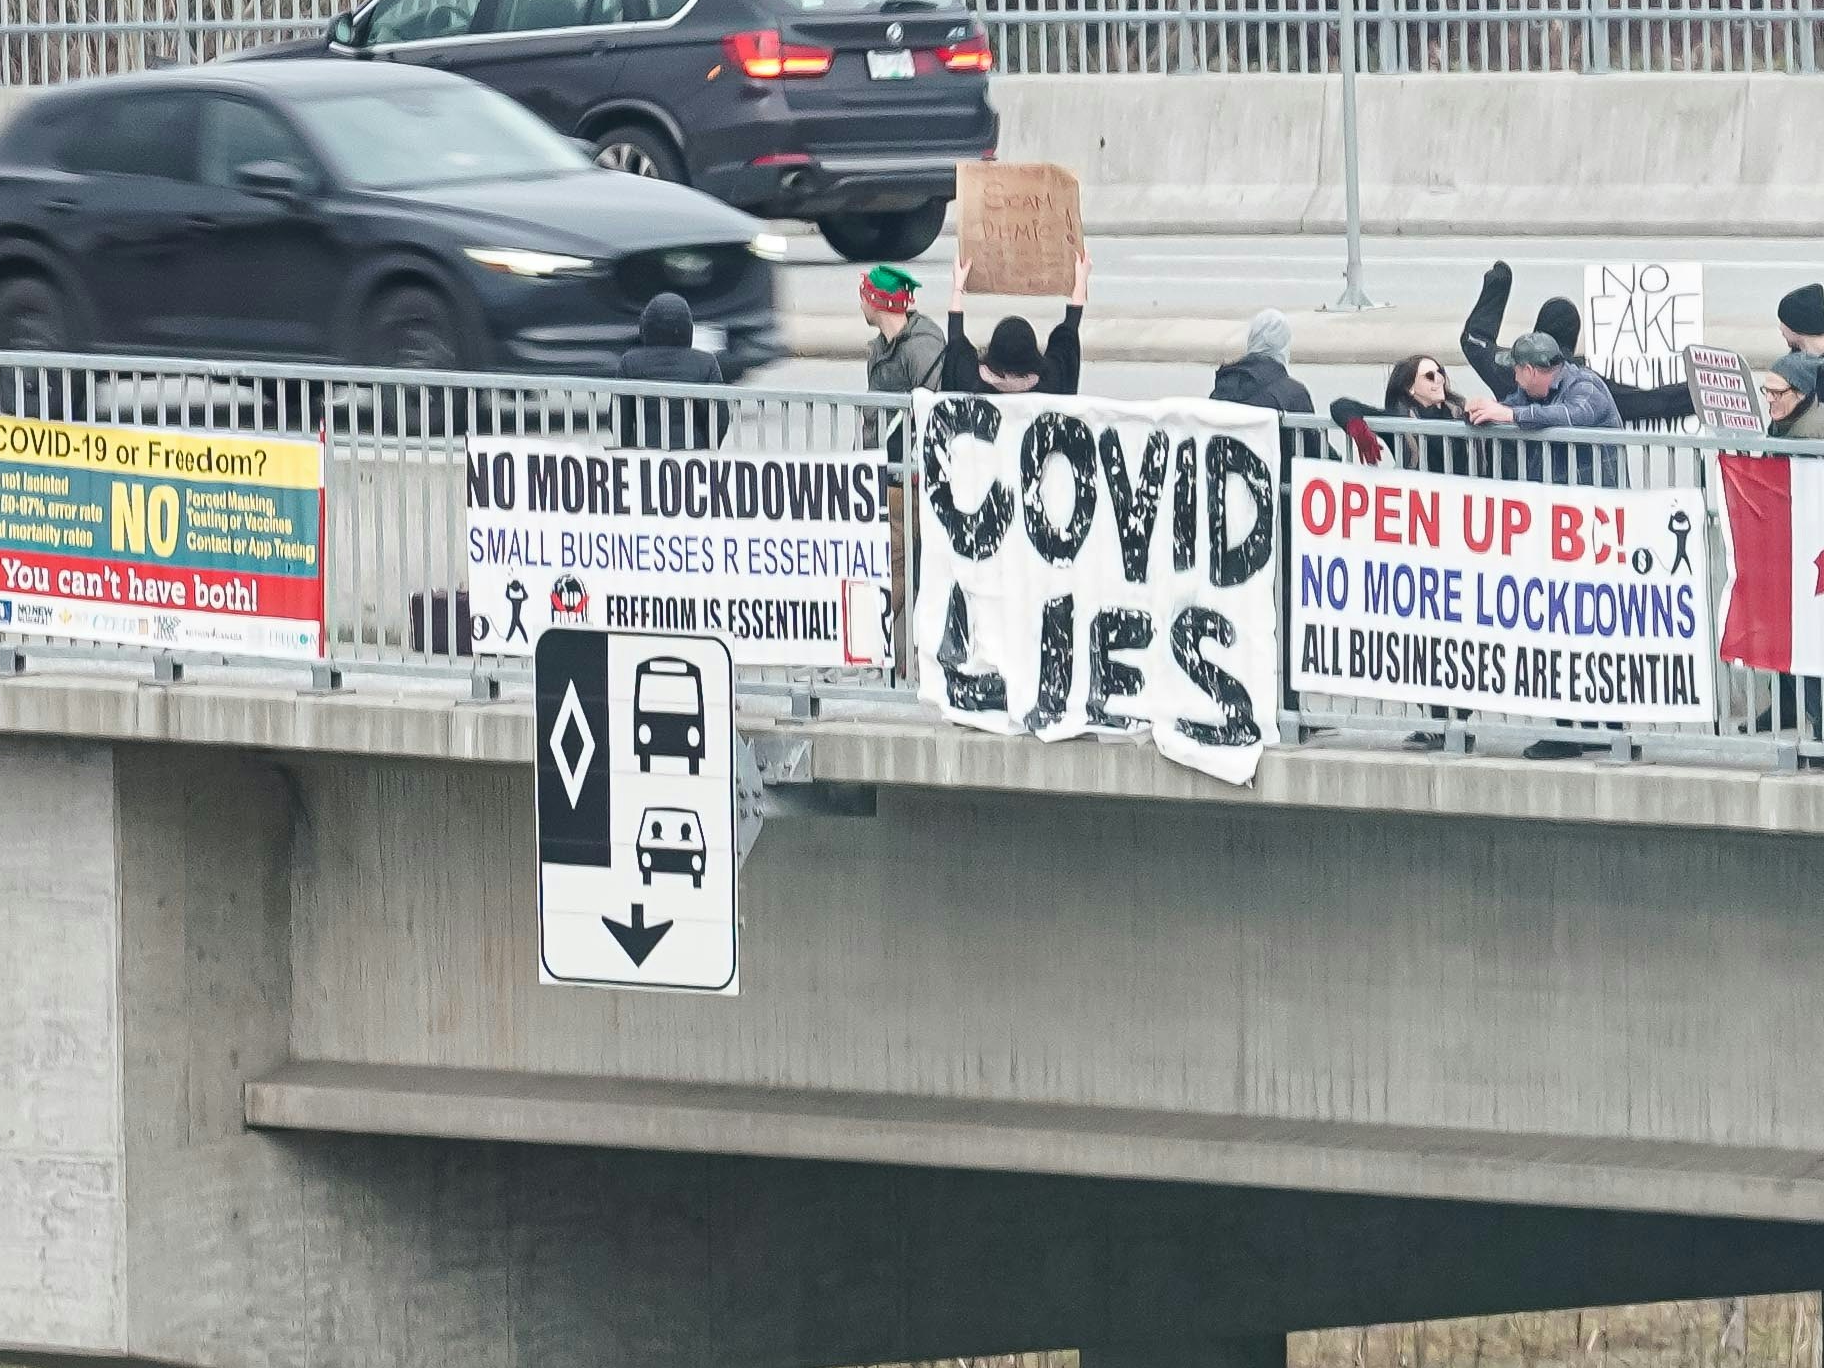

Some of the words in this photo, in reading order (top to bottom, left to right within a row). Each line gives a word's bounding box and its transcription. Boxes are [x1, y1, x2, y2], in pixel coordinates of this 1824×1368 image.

[1602, 263, 1670, 296] NO
[1590, 292, 1700, 356] FAKE
[1698, 370, 1743, 391] HEALTHY
[1703, 392, 1749, 412] CHILDREN
[1, 469, 21, 491] not
[116, 444, 140, 466] or
[148, 440, 268, 477] Freedom?
[185, 487, 227, 509] Forced
[466, 450, 516, 512] NO
[527, 453, 632, 517] MORE
[639, 456, 889, 524] LOCKDOWNS!
[921, 396, 1276, 588] COVID
[8, 521, 61, 548] mortality
[62, 528, 94, 548] rates
[47, 502, 78, 521] error
[79, 502, 104, 524] rate
[110, 480, 180, 558] NO
[186, 506, 229, 533] Testing
[229, 514, 242, 530] or
[243, 513, 293, 535] Vaccines
[1300, 477, 1441, 549] OPEN
[1462, 492, 1533, 557] UP
[1550, 502, 1628, 566] BC!
[185, 530, 232, 556] Contact
[233, 538, 248, 554] or
[248, 536, 273, 561] App
[273, 537, 316, 565] Tracing
[469, 525, 553, 569] SMALL
[560, 531, 715, 575] BUSINESSES
[723, 536, 740, 576] R
[747, 538, 892, 580] ESSENTIAL!
[1, 557, 50, 592] You
[57, 564, 122, 601] can't
[127, 568, 186, 606] have
[193, 573, 258, 613] both!
[1301, 553, 1349, 611] NO
[1363, 559, 1464, 624] MORE
[1476, 571, 1696, 639] LOCKDOWNS
[605, 593, 697, 631] FREEDOM
[702, 596, 723, 631] IS
[726, 598, 839, 644] ESSENTIAL!
[936, 579, 1263, 746] LIES
[1300, 623, 1344, 678] ALL
[1348, 628, 1507, 696] BUSINESSES
[1514, 645, 1562, 701] ARE
[1569, 650, 1702, 707] ESSENTIAL
